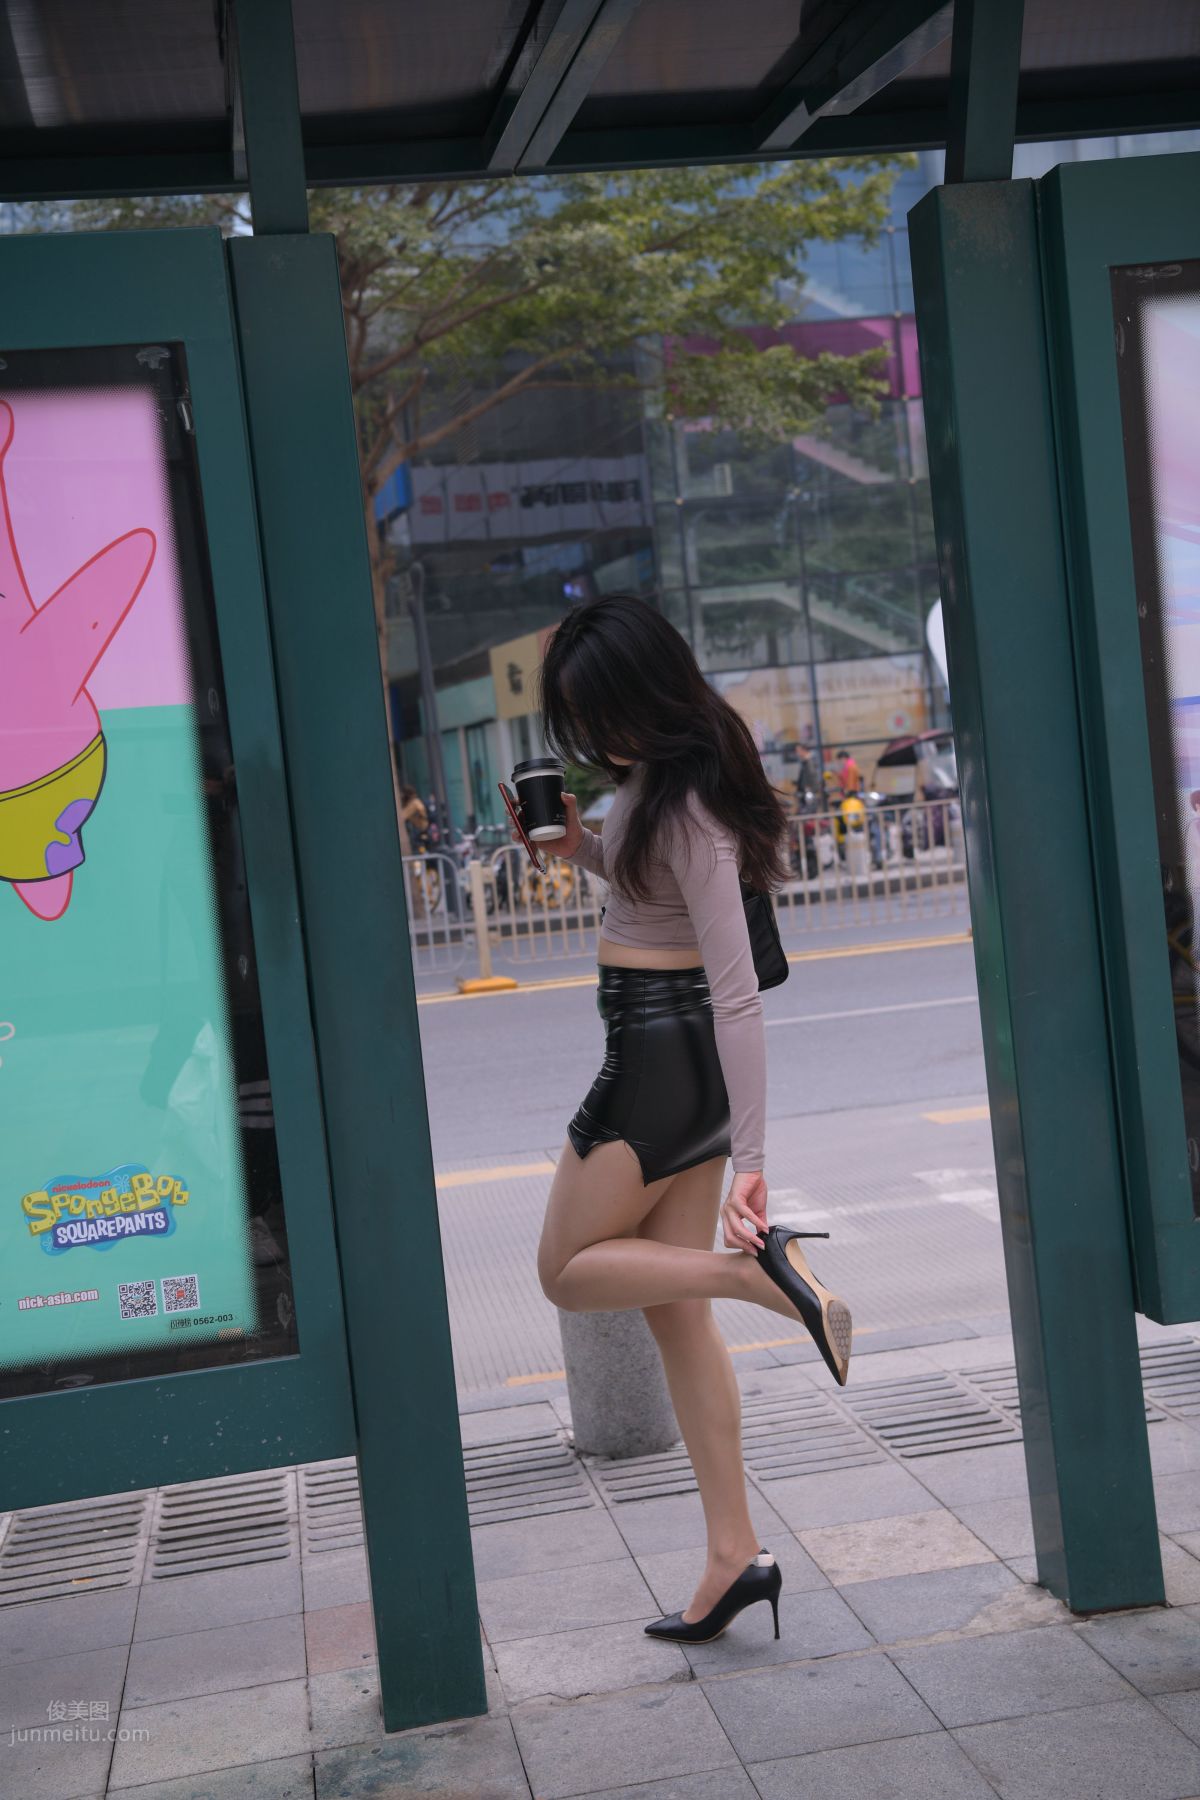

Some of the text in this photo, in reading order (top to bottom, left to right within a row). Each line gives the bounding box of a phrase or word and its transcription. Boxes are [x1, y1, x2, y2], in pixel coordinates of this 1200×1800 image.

[56, 1211, 166, 1244] SQUAREPANTS
[18, 1289, 99, 1310] nick-asia.com
[193, 1313, 234, 1326] 0562-003
